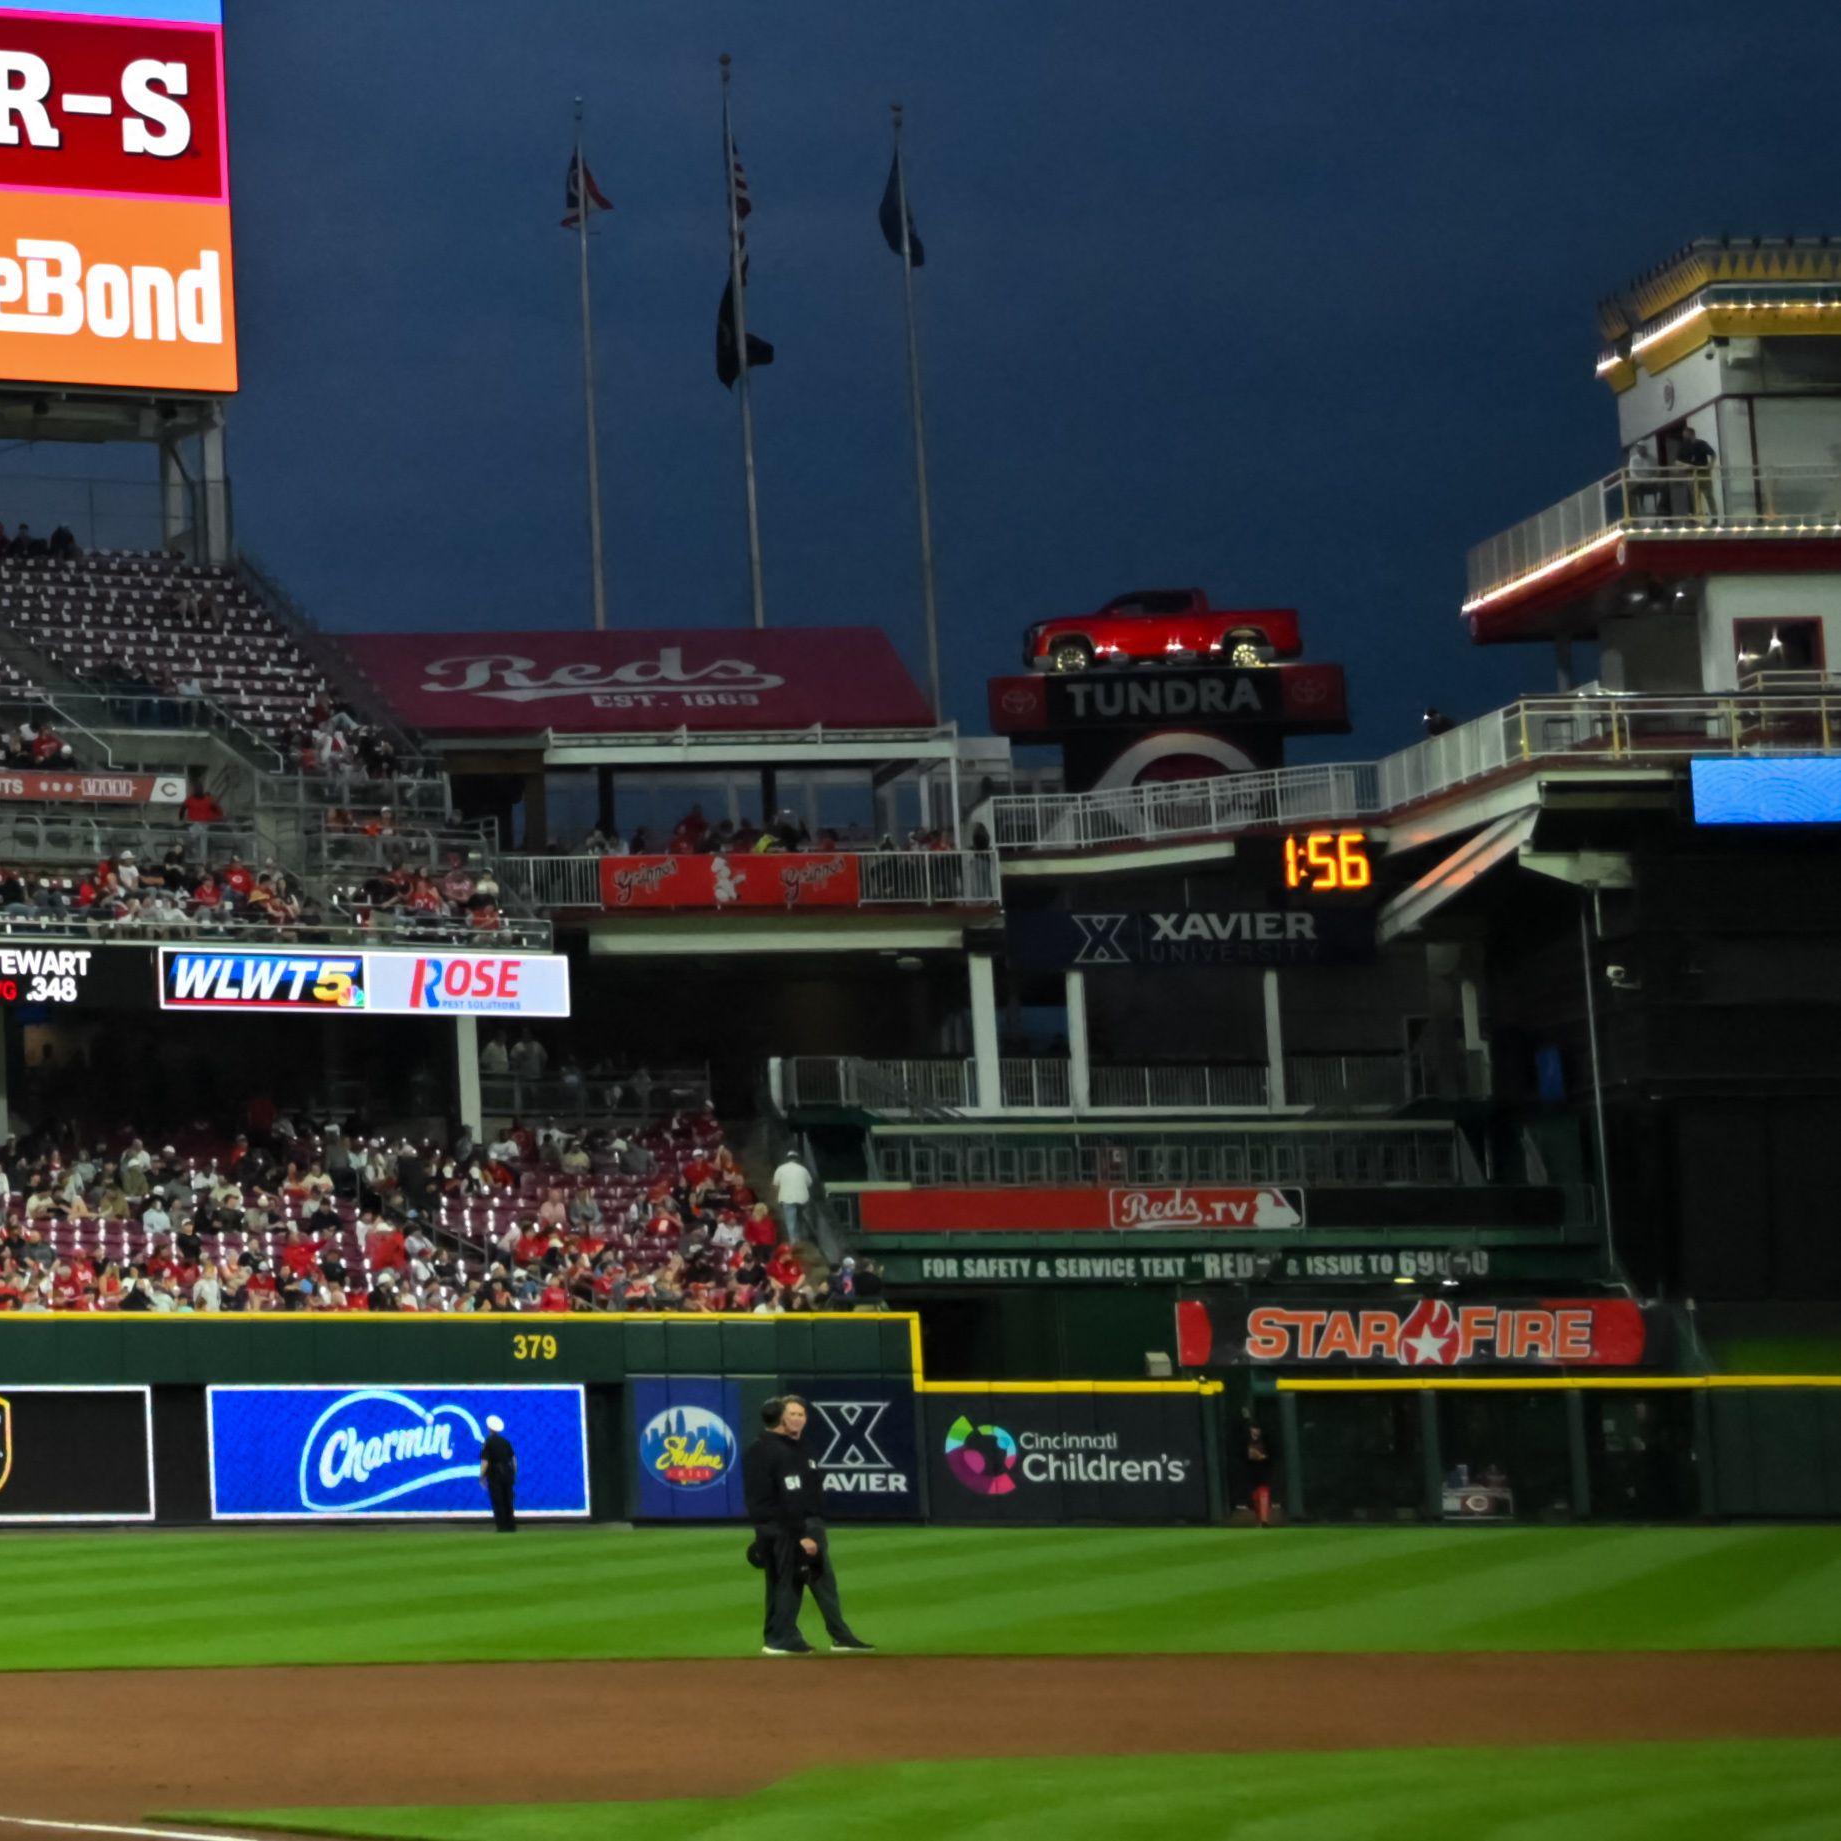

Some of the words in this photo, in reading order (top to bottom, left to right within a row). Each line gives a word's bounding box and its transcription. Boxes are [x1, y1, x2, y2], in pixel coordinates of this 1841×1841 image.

[420, 647, 785, 701] Reds
[590, 693, 669, 708] EST.
[681, 692, 760, 707] 1869
[1066, 677, 1261, 718] TUNDRA
[1285, 832, 1371, 889] 1:56
[1150, 911, 1317, 941] XAVIER
[1150, 943, 1319, 961] UNIVERSITY
[26, 978, 78, 1002] .348
[410, 958, 521, 1008] ROSE
[922, 1258, 959, 1278] FOR
[963, 1258, 1031, 1278] SAFETY
[1036, 1259, 1051, 1278] &
[1055, 1257, 1137, 1278] SERVICE
[1140, 1257, 1185, 1277] TEXT
[1286, 1258, 1300, 1276] &
[1306, 1255, 1364, 1275] ISSUE
[1368, 1254, 1393, 1274] TO
[513, 1335, 558, 1360] 379
[1246, 1308, 1401, 1360] STAR
[1459, 1305, 1596, 1359] FIRE
[319, 1418, 453, 1488] Charmin
[655, 1435, 724, 1469] Skyline
[1019, 1431, 1117, 1450] Cincinnati
[1023, 1453, 1186, 1483] Children's
